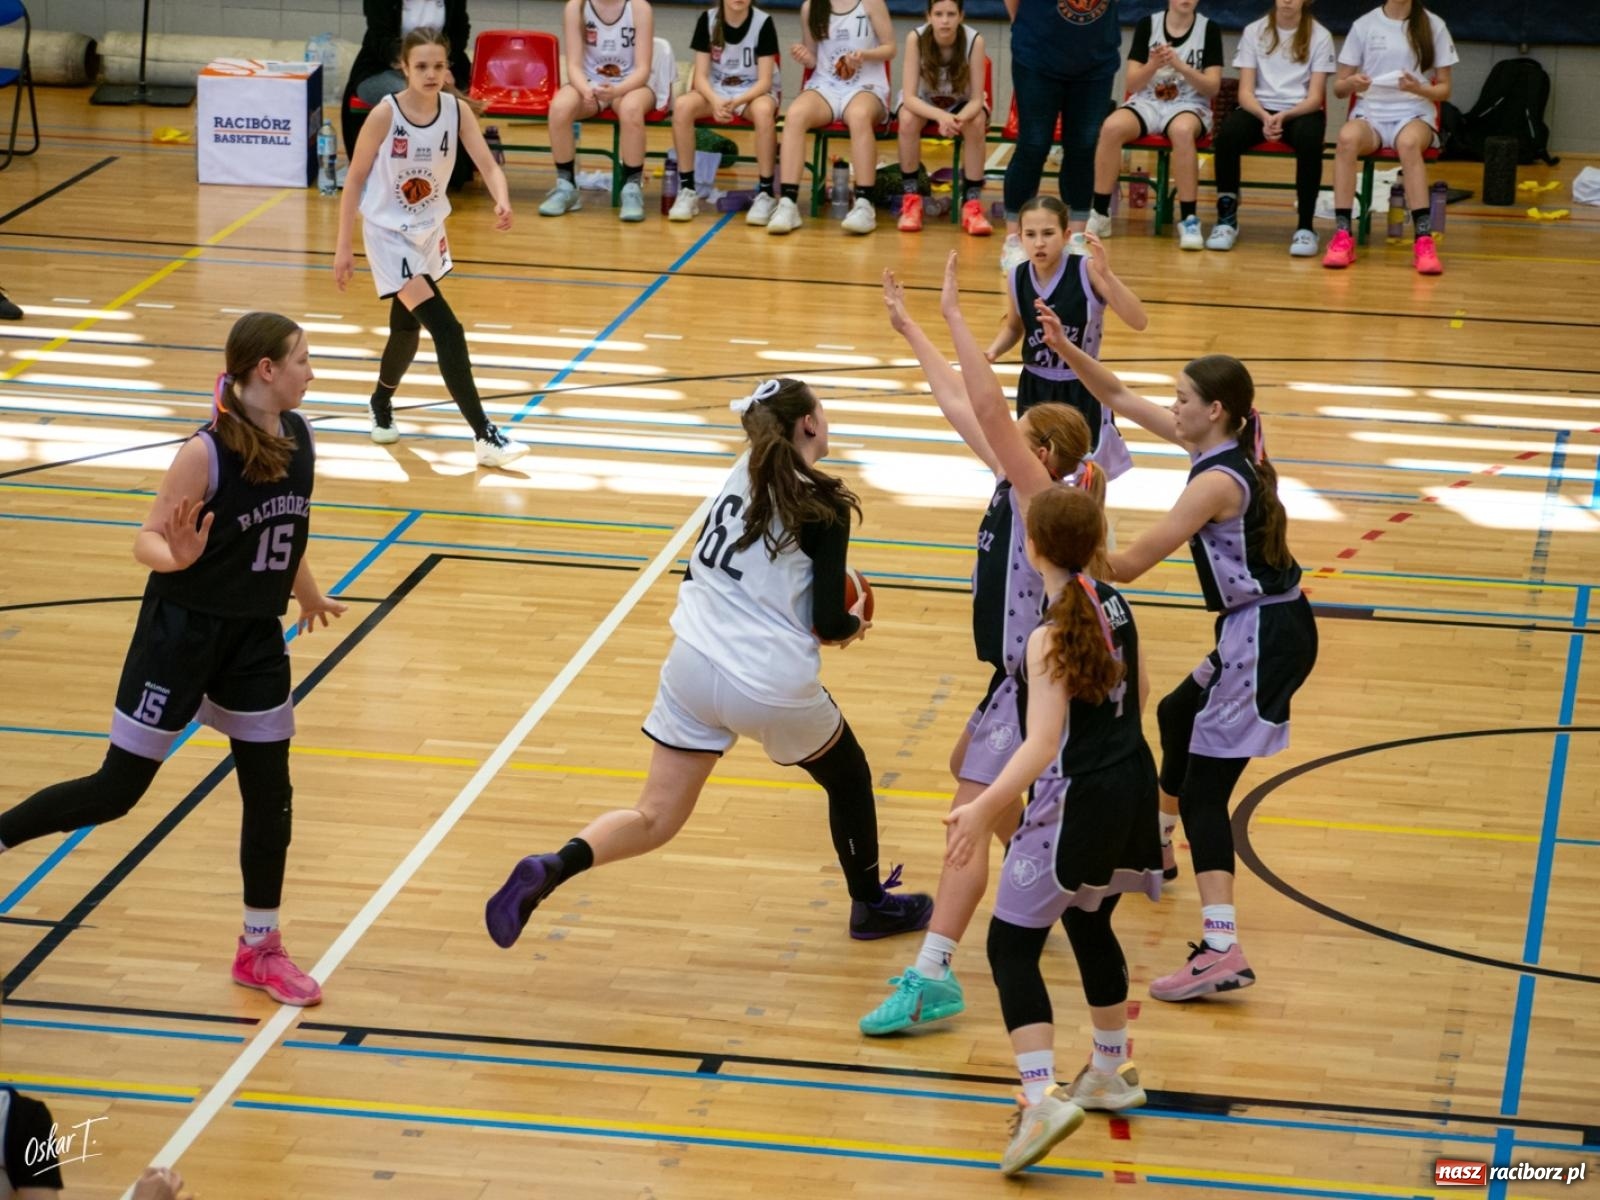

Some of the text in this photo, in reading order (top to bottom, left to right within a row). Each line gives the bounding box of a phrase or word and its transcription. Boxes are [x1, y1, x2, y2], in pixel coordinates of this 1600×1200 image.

[213, 114, 292, 132] RACIBÓRZ
[213, 133, 292, 146] BASKETBALL
[440, 130, 449, 158] 4
[401, 256, 413, 279] 4
[237, 490, 311, 532] RACIBÓRZ
[251, 523, 295, 572] 15
[132, 688, 168, 726] 15
